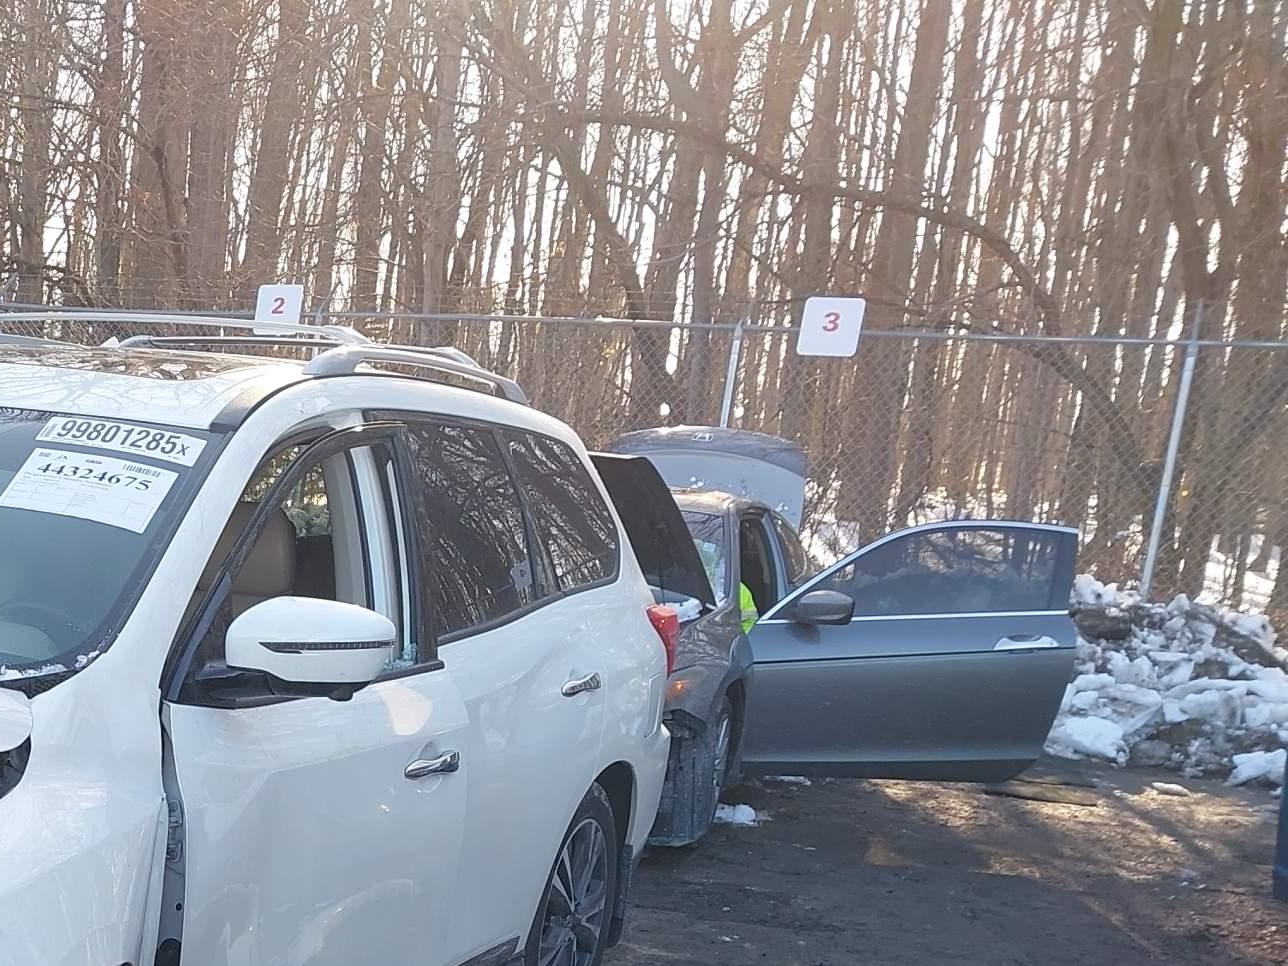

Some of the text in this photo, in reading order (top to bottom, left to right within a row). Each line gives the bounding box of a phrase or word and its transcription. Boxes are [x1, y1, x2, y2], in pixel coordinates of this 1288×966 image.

[272, 297, 286, 315] 2
[822, 312, 841, 332] 3
[37, 463, 152, 492] 44324675
